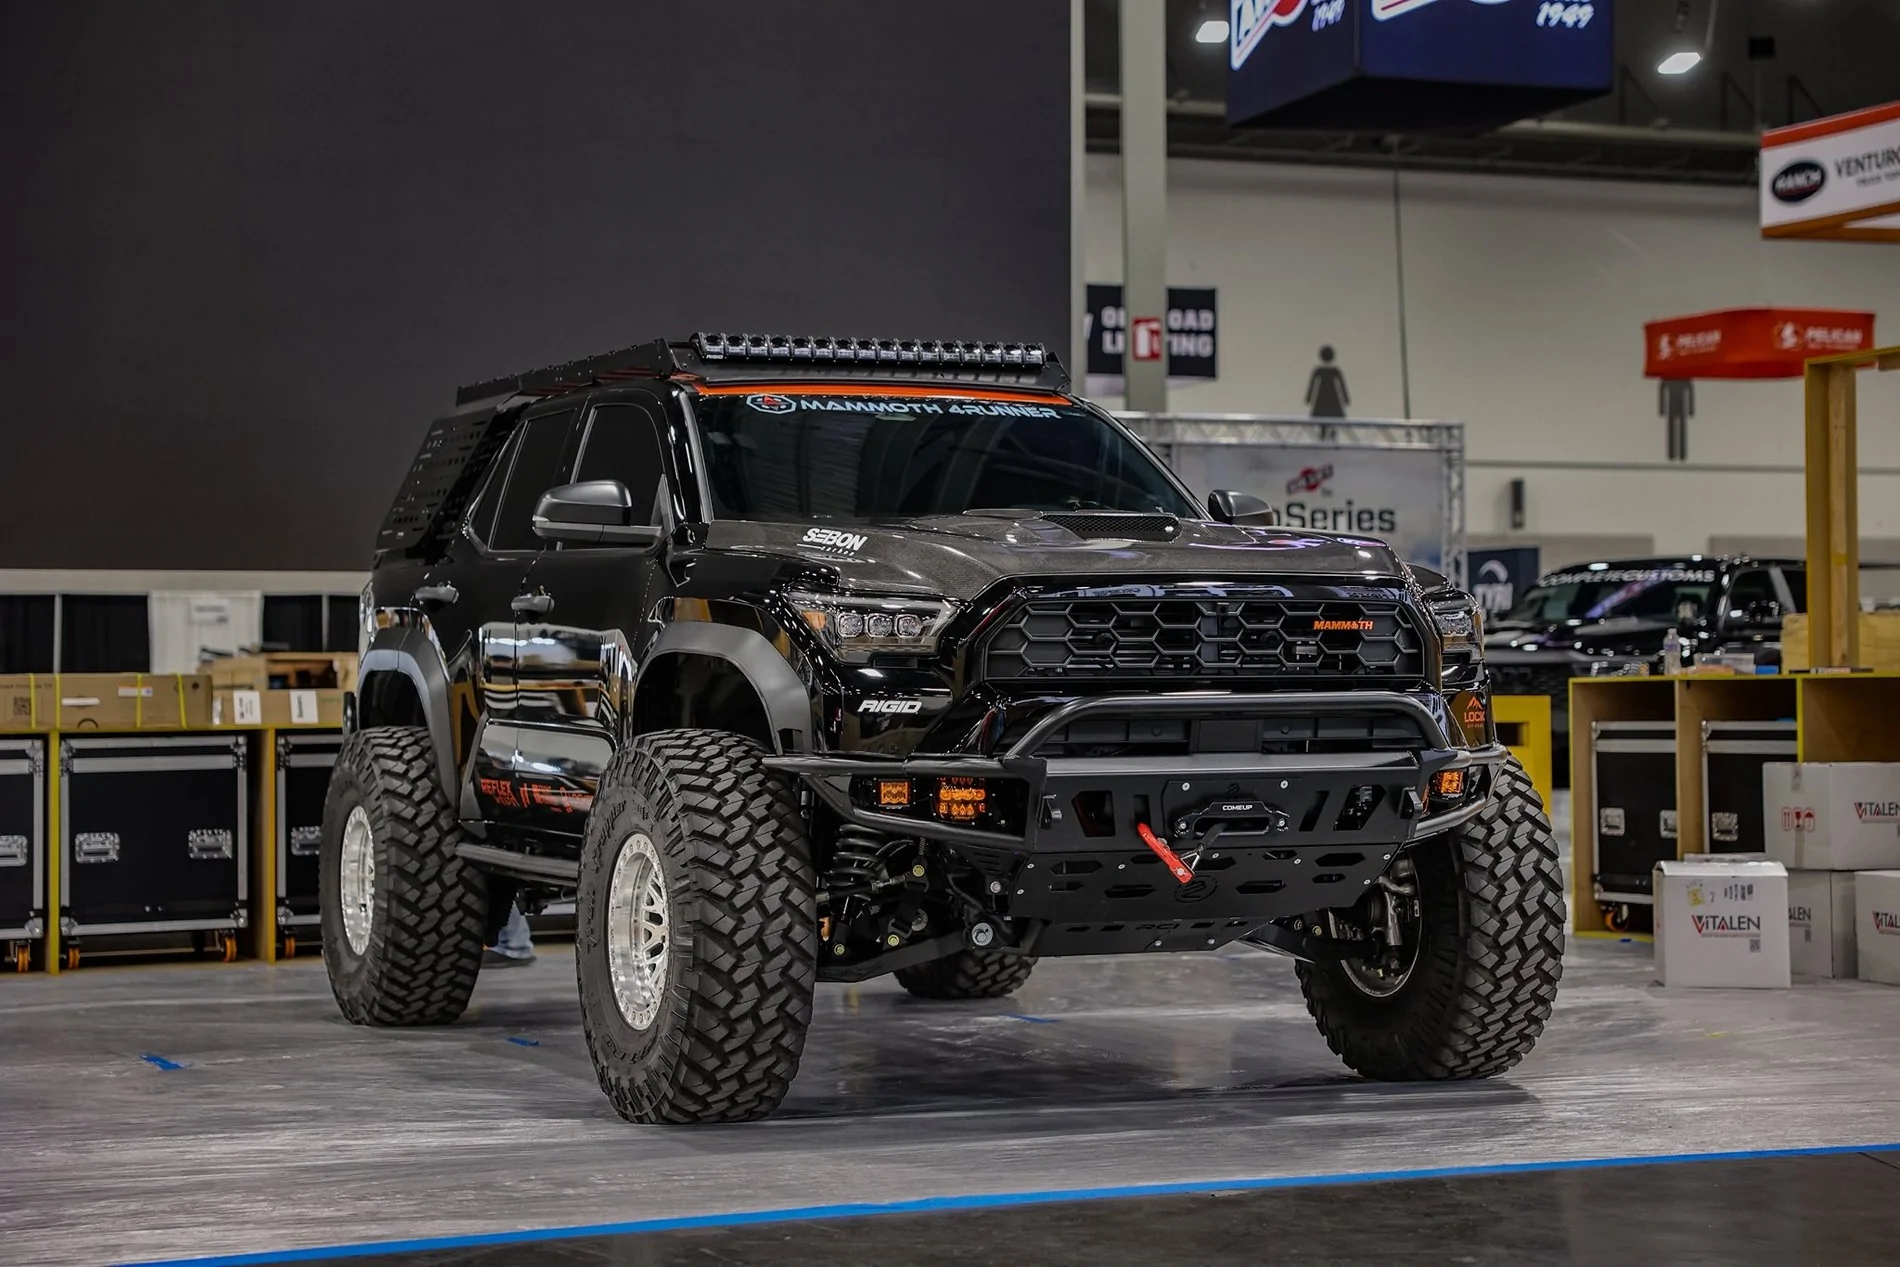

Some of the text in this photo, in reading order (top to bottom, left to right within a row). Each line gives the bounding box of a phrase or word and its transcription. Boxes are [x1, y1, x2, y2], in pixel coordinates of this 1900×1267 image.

[1536, 1, 1595, 29] 1949
[800, 400, 1062, 419] MAMMOTH 4RUNNER
[802, 528, 868, 551] SEBON
[857, 700, 923, 713] RIGID
[1464, 711, 1485, 723] LOCK
[1788, 906, 1811, 922] ALEN
[1872, 910, 1900, 931] ViTAL
